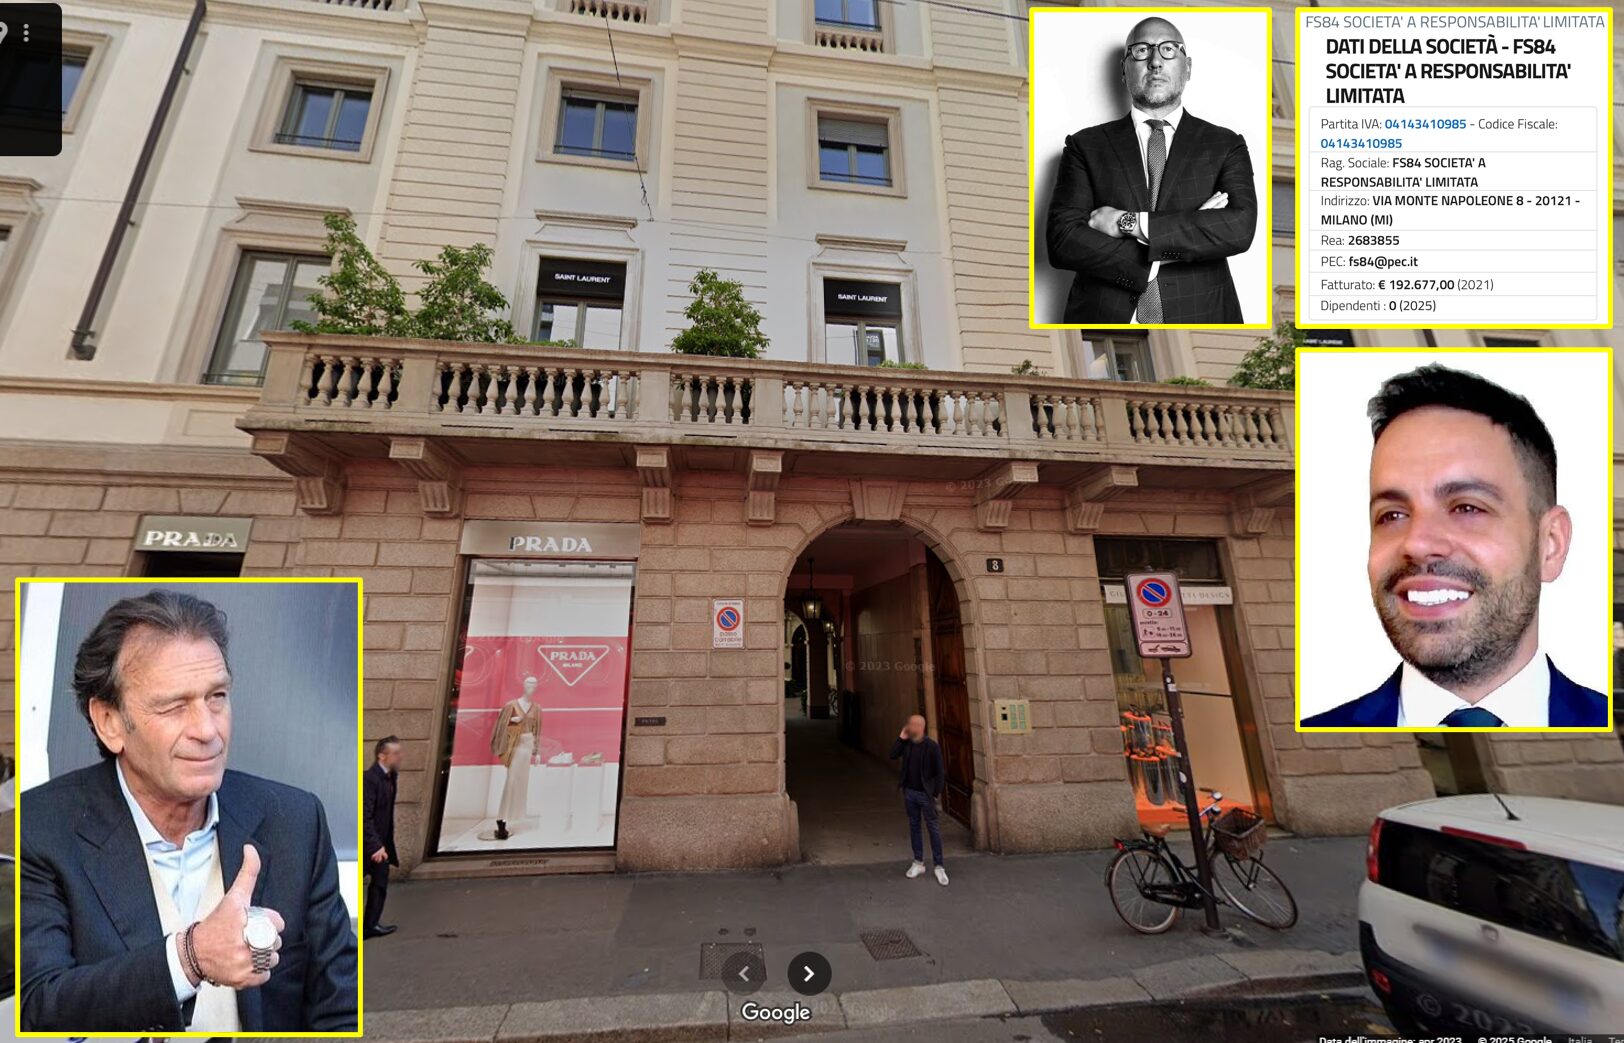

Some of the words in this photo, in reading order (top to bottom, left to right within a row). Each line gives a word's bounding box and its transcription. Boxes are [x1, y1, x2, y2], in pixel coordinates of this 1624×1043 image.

[554, 273, 576, 281] SAINT
[576, 275, 611, 284] LAURENT
[837, 293, 857, 301] SAINT
[857, 295, 888, 303] LAURENT
[143, 530, 238, 548] PRADA
[508, 536, 593, 552] PRADA
[992, 560, 999, 571] 8
[551, 651, 597, 661] PRADA
